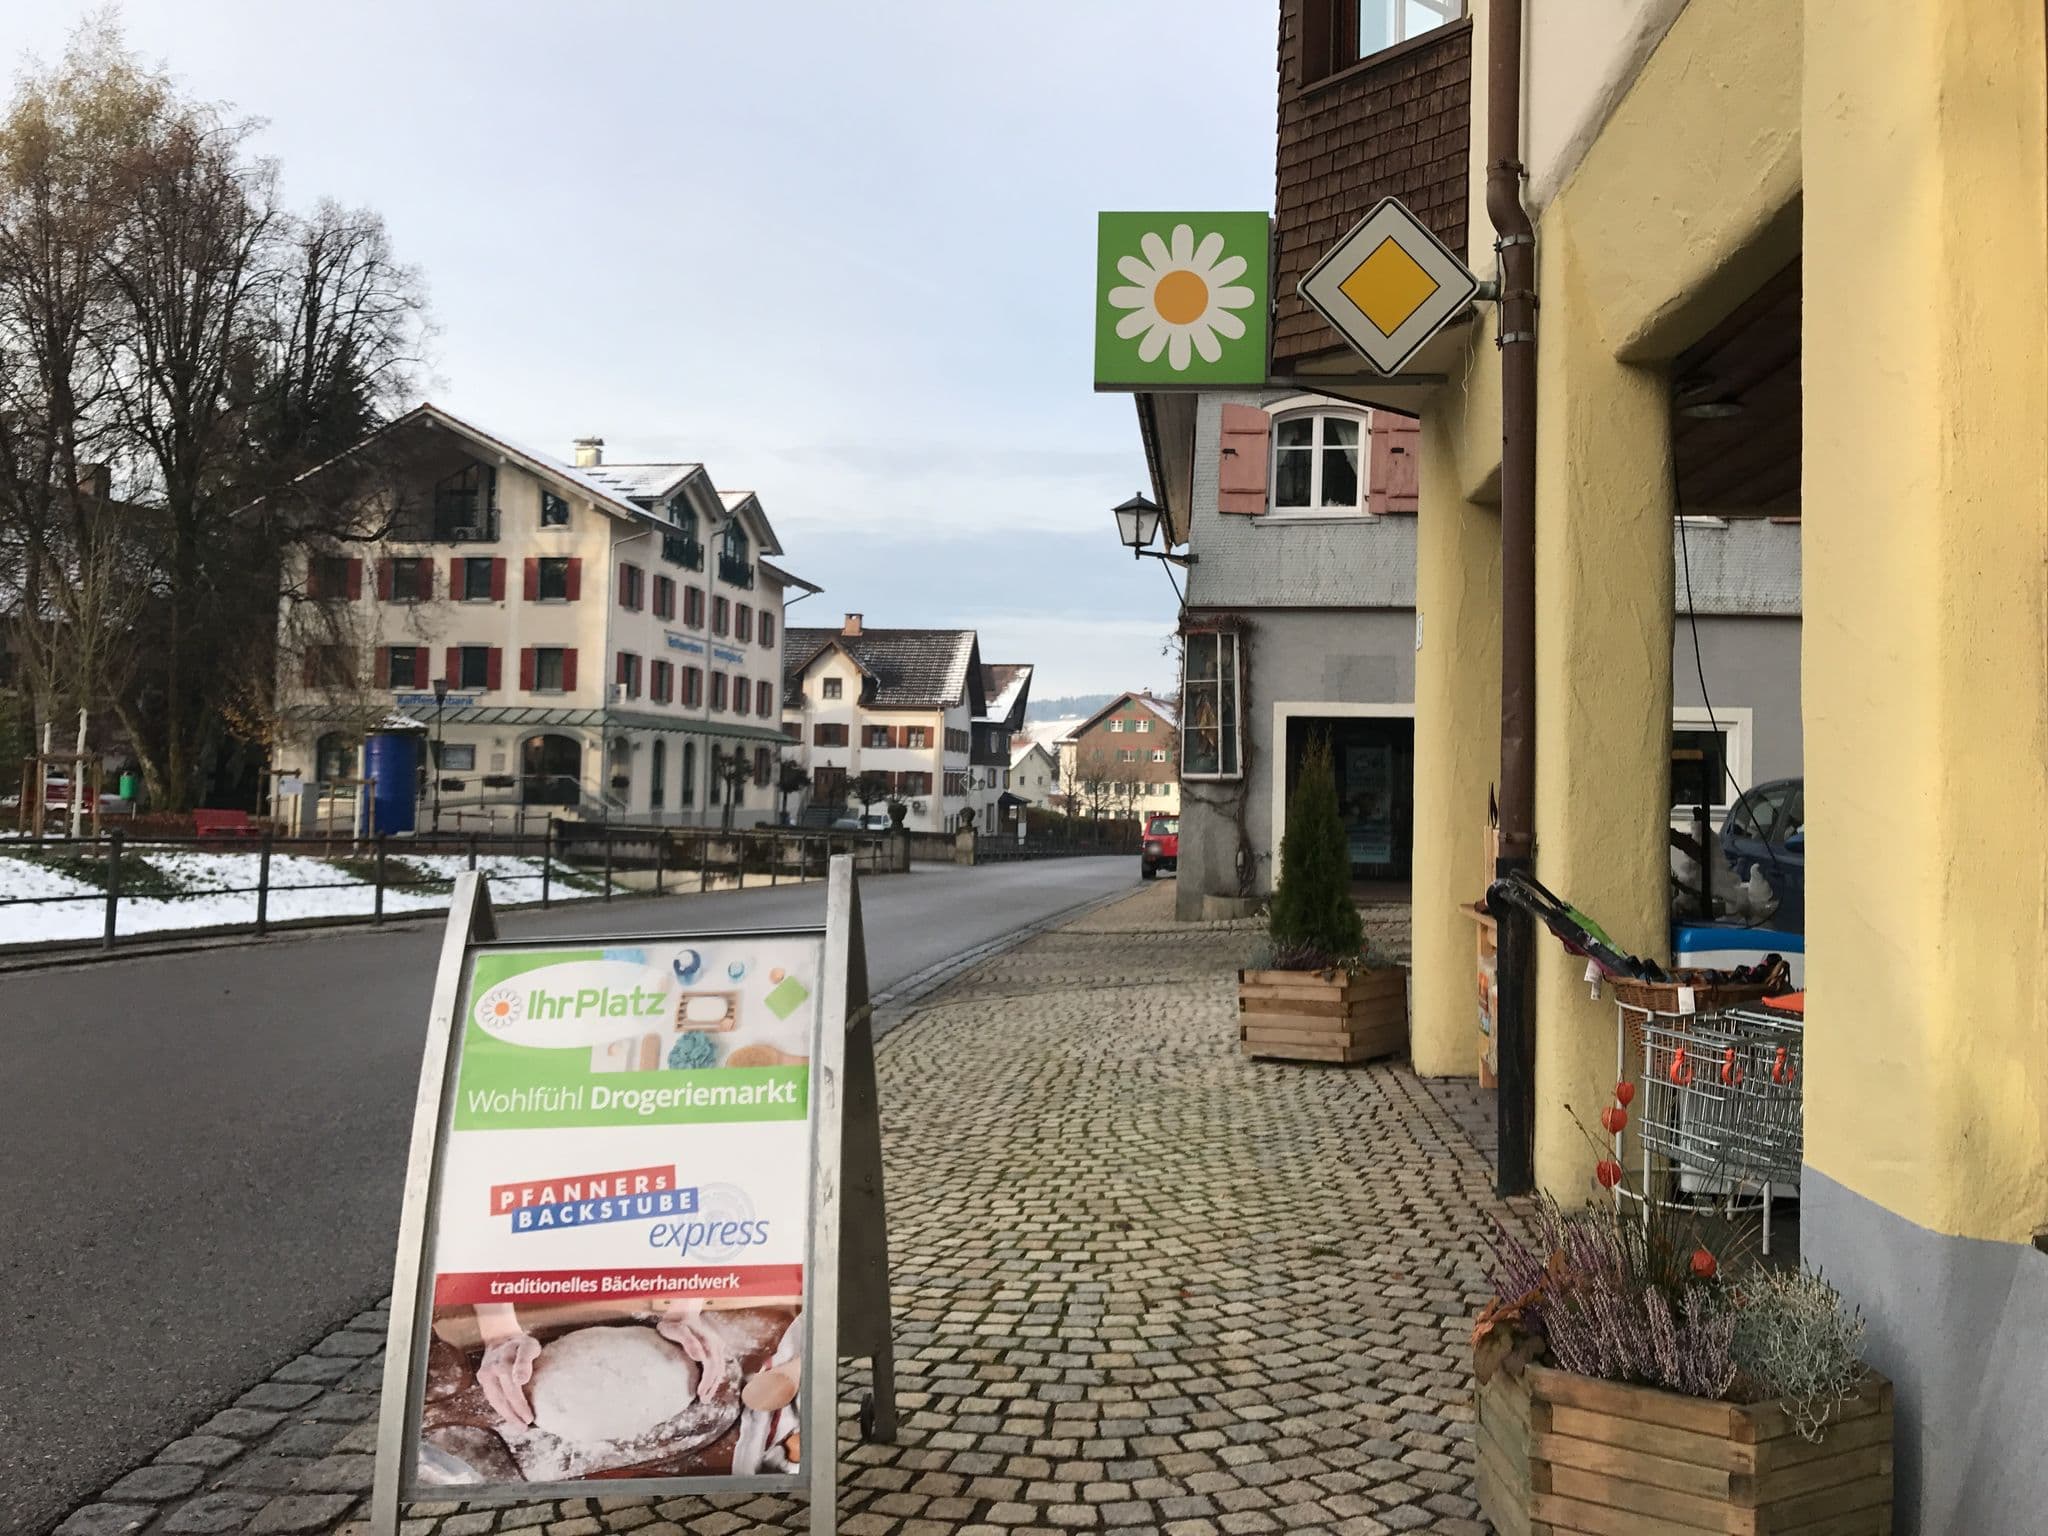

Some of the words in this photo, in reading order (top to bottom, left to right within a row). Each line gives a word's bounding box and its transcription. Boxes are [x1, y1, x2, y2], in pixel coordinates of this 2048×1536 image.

[527, 985, 667, 1020] IhrPlatz
[467, 1084, 584, 1113] Wohlfühl
[590, 1079, 798, 1115] Drogeriemarkt
[518, 1192, 692, 1228] BACKSTUBE
[649, 1218, 770, 1257] express
[490, 1276, 598, 1295] traditionelles
[601, 1272, 740, 1292] Bäckerhandwerk
